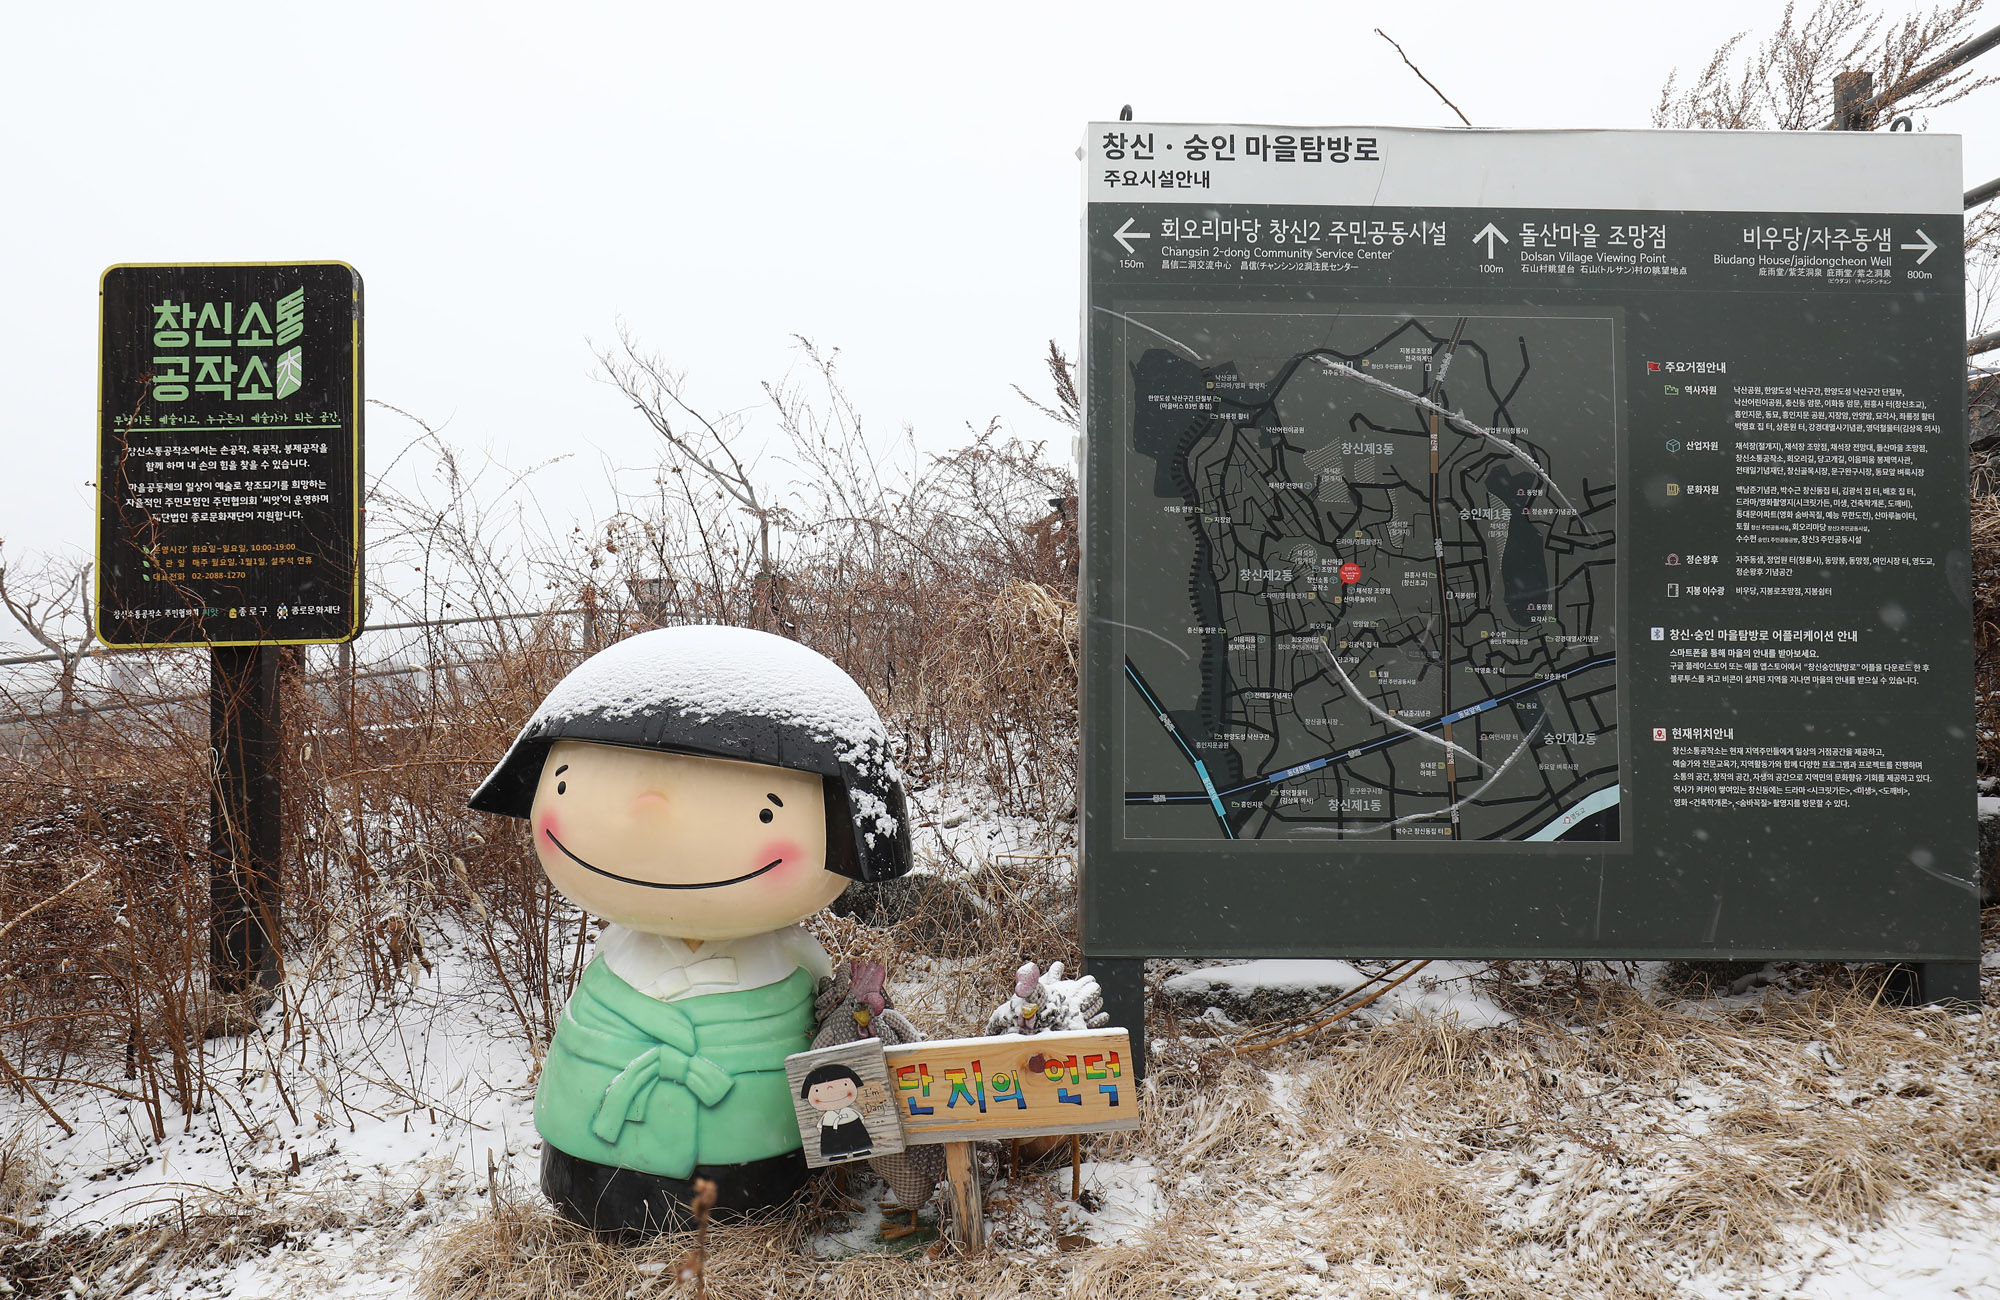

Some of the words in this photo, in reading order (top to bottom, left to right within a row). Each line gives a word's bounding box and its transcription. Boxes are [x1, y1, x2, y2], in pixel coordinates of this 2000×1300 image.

[1102, 132, 1154, 160] 창신
[1184, 134, 1236, 162] 숭인
[1246, 134, 1380, 164] 마을탐방로
[1104, 170, 1210, 188] 주요시설안내
[1160, 217, 1262, 244] 회오리마당
[1270, 218, 1320, 244] 창신2
[1328, 220, 1446, 246] 주민공동시설
[1518, 222, 1600, 248] 돌산마을
[1608, 224, 1666, 248] 조망점
[1744, 226, 1890, 252] 비우당/자주동샘
[1161, 246, 1209, 258] Changsin
[1213, 246, 1250, 260] 2-dong
[1254, 248, 1313, 261] Community
[1316, 248, 1354, 260] Service
[1357, 249, 1393, 260] Center
[1520, 251, 1556, 262] Dolsan
[1558, 252, 1593, 264] Village
[1596, 252, 1637, 266] Viewing
[1640, 253, 1666, 264] Point
[1120, 260, 1144, 268] 150m
[1714, 254, 1756, 266] Biudang
[1758, 254, 1867, 268] House/jajidongcheon
[1870, 256, 1892, 267] Well
[1480, 265, 1504, 274] 100m
[1908, 270, 1932, 280] 800m
[153, 285, 304, 348] 창신소통
[1664, 362, 1726, 374] 주요거점안내
[152, 356, 274, 402] 공작소
[1684, 386, 1716, 396] 역사자원
[158, 413, 200, 425] 예술이고,
[206, 412, 244, 424] 누구든지
[251, 412, 288, 424] 예술가가
[294, 412, 314, 422] 되는
[220, 444, 250, 456] 손공작,
[284, 443, 328, 454] 봉제공작을
[1341, 442, 1394, 456] 창신제3동
[1686, 440, 1718, 450] 산업자원
[146, 462, 164, 472] 함께
[166, 461, 184, 470] 하며
[186, 460, 196, 470] 내
[198, 460, 216, 471] 손의
[220, 460, 238, 470] 힘을
[240, 460, 258, 470] 찾을
[260, 460, 270, 470] 수
[272, 458, 310, 470] 있습니다.
[186, 482, 212, 492] 일상이
[214, 482, 242, 492] 예술로
[244, 480, 290, 492] 창조되기를
[292, 480, 326, 490] 희망하는
[1686, 484, 1718, 494] 문화자원
[164, 496, 210, 508] 주민모임인
[212, 496, 258, 507] 주민협의회
[294, 494, 328, 506] 운영하며
[190, 512, 254, 522] 종로문화재단이
[256, 510, 304, 522] 지원합니다.
[1459, 508, 1512, 520] 숭인제1동
[1686, 554, 1719, 564] 정순왕후
[192, 572, 246, 580] 02-2088-1270
[1240, 569, 1293, 582] 창신제2동
[1736, 568, 1764, 576] 정순왕후
[1764, 568, 1792, 576] 기념공간
[1686, 586, 1702, 596] 지봉
[1702, 586, 1724, 596] 이수광
[291, 604, 340, 616] 종로문화재단
[1670, 628, 1714, 640] 창신·숭인
[1718, 630, 1770, 642] 마을탐방로
[1772, 630, 1834, 642] 어플리케이션
[1836, 630, 1858, 642] 안내
[1670, 648, 1708, 658] 스마트폰을
[1710, 648, 1726, 658] 통해
[1728, 648, 1750, 658] 마을의
[1752, 648, 1776, 658] 안내를
[1778, 648, 1820, 658] 받아보세요.
[1544, 733, 1597, 746] 숭인제2동
[1672, 728, 1734, 740] 현재위치안내
[1328, 799, 1381, 812] 창신제1동
[896, 1060, 1026, 1116] 단지의
[1044, 1051, 1122, 1106] 언덕
